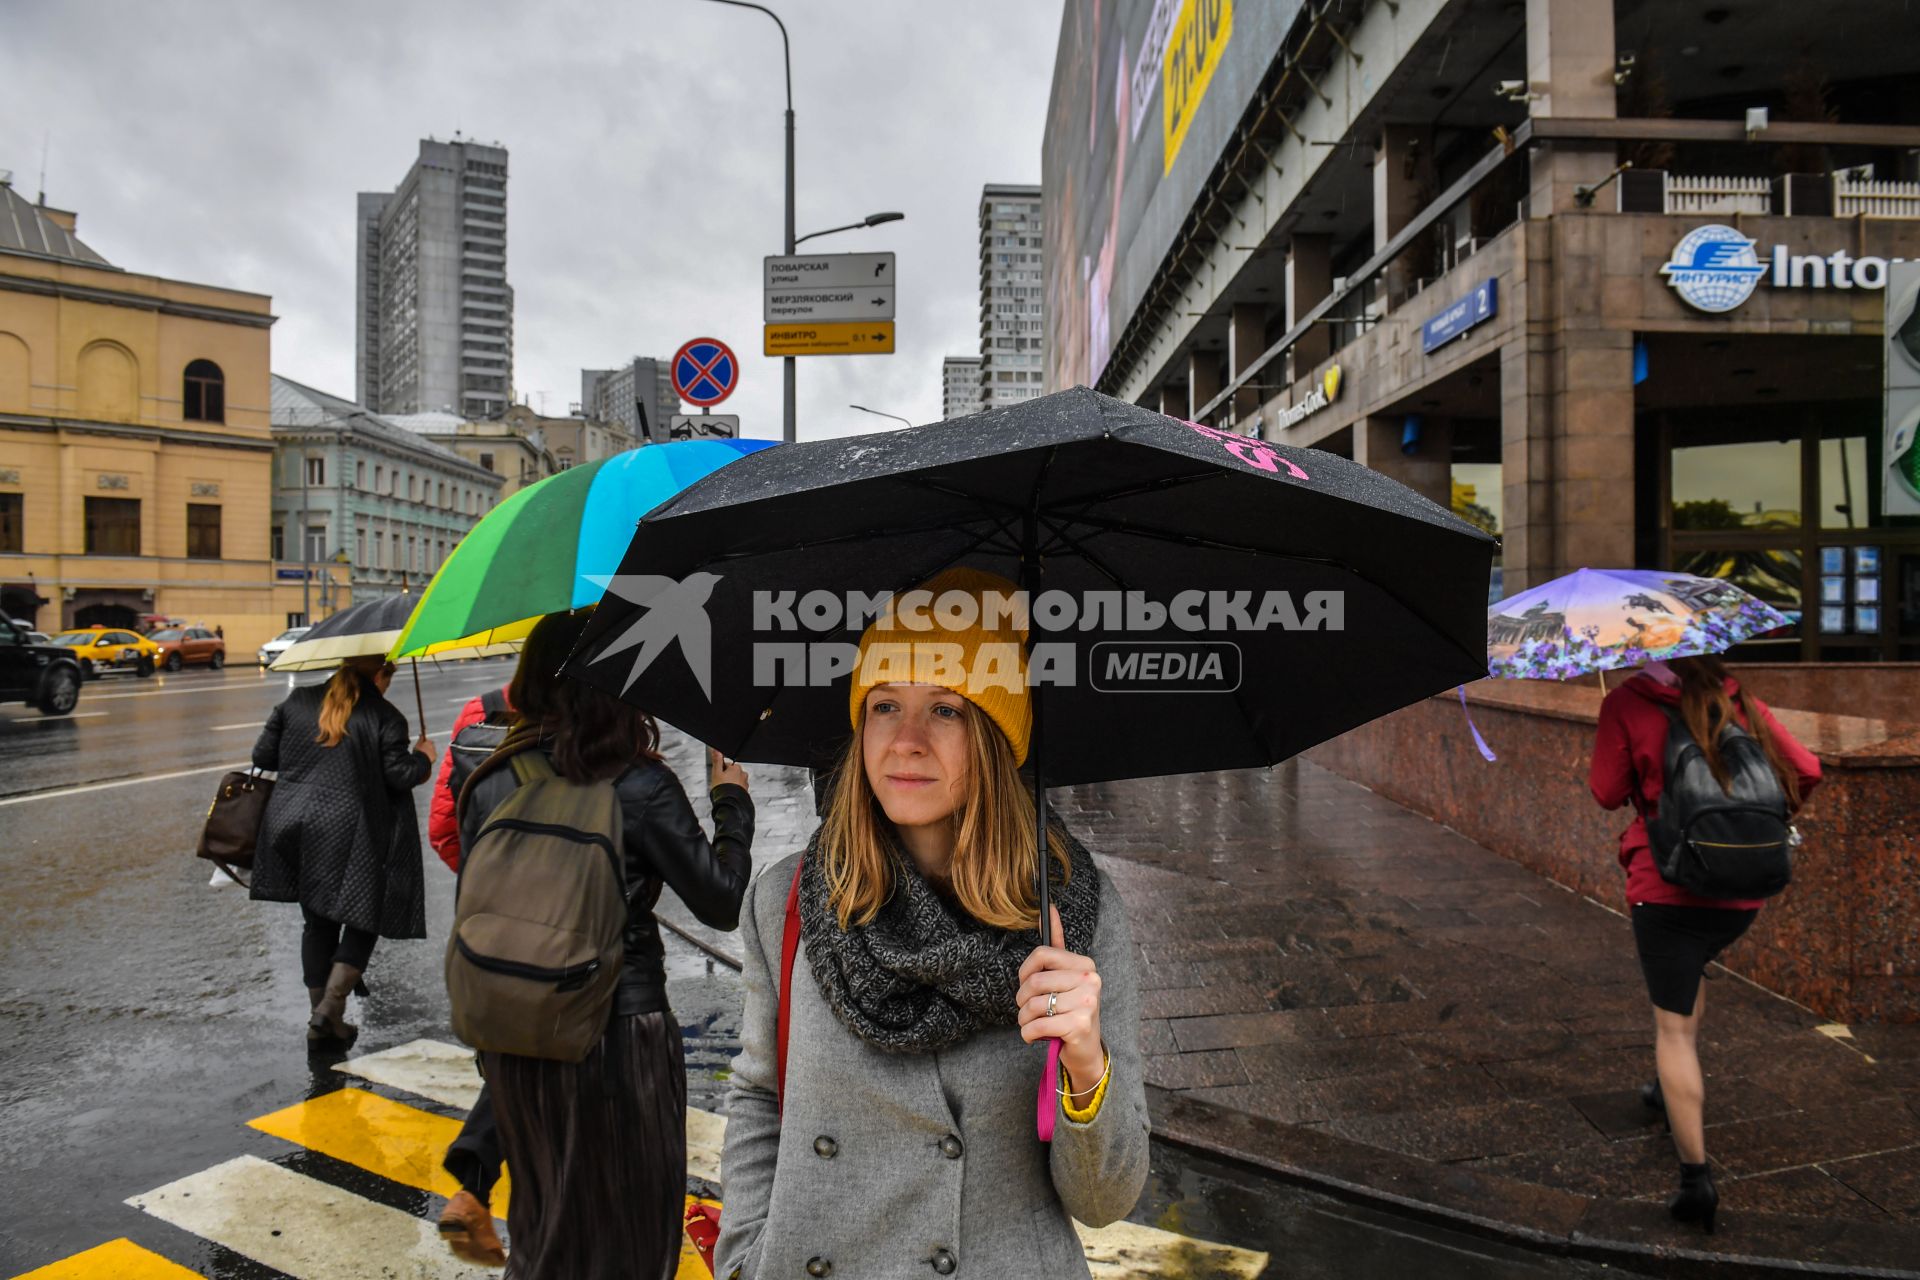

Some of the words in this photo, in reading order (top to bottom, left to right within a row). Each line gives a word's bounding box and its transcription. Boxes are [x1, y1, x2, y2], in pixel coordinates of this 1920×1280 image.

[771, 262, 829, 272] ПОВАРСКАЯ
[1773, 244, 1919, 289] Into
[771, 275, 798, 283] улица
[1674, 272, 1758, 285] ИНТУРИСТ
[771, 292, 853, 304] МЕРЗЛЯКОВСКИЙ
[1478, 288, 1487, 315] 2
[771, 306, 813, 315] переулок
[770, 331, 817, 340] ИНВИТРО
